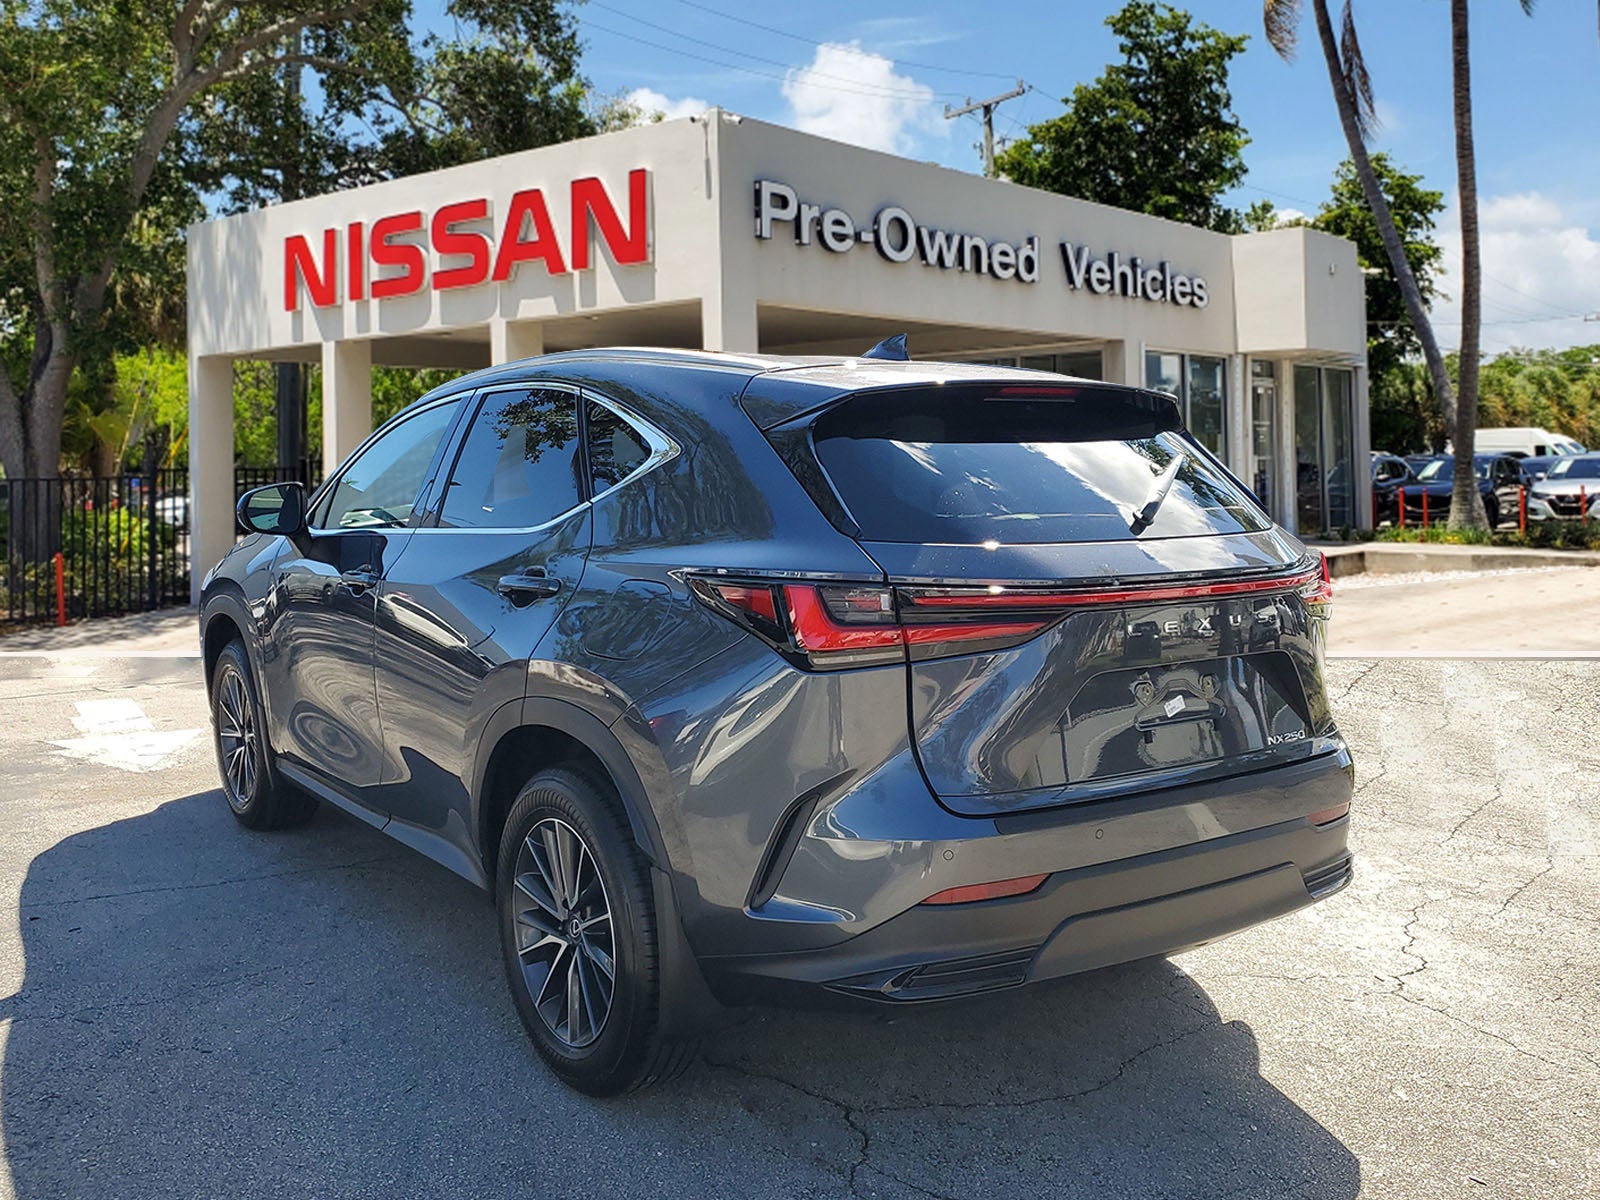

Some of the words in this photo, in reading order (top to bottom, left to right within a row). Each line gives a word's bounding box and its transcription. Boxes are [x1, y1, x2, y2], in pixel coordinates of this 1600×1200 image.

[285, 168, 650, 312] NISSAN
[755, 180, 1039, 283] Pre-Owned
[1059, 243, 1209, 308] Vehicles
[1127, 612, 1277, 637] LEXUS
